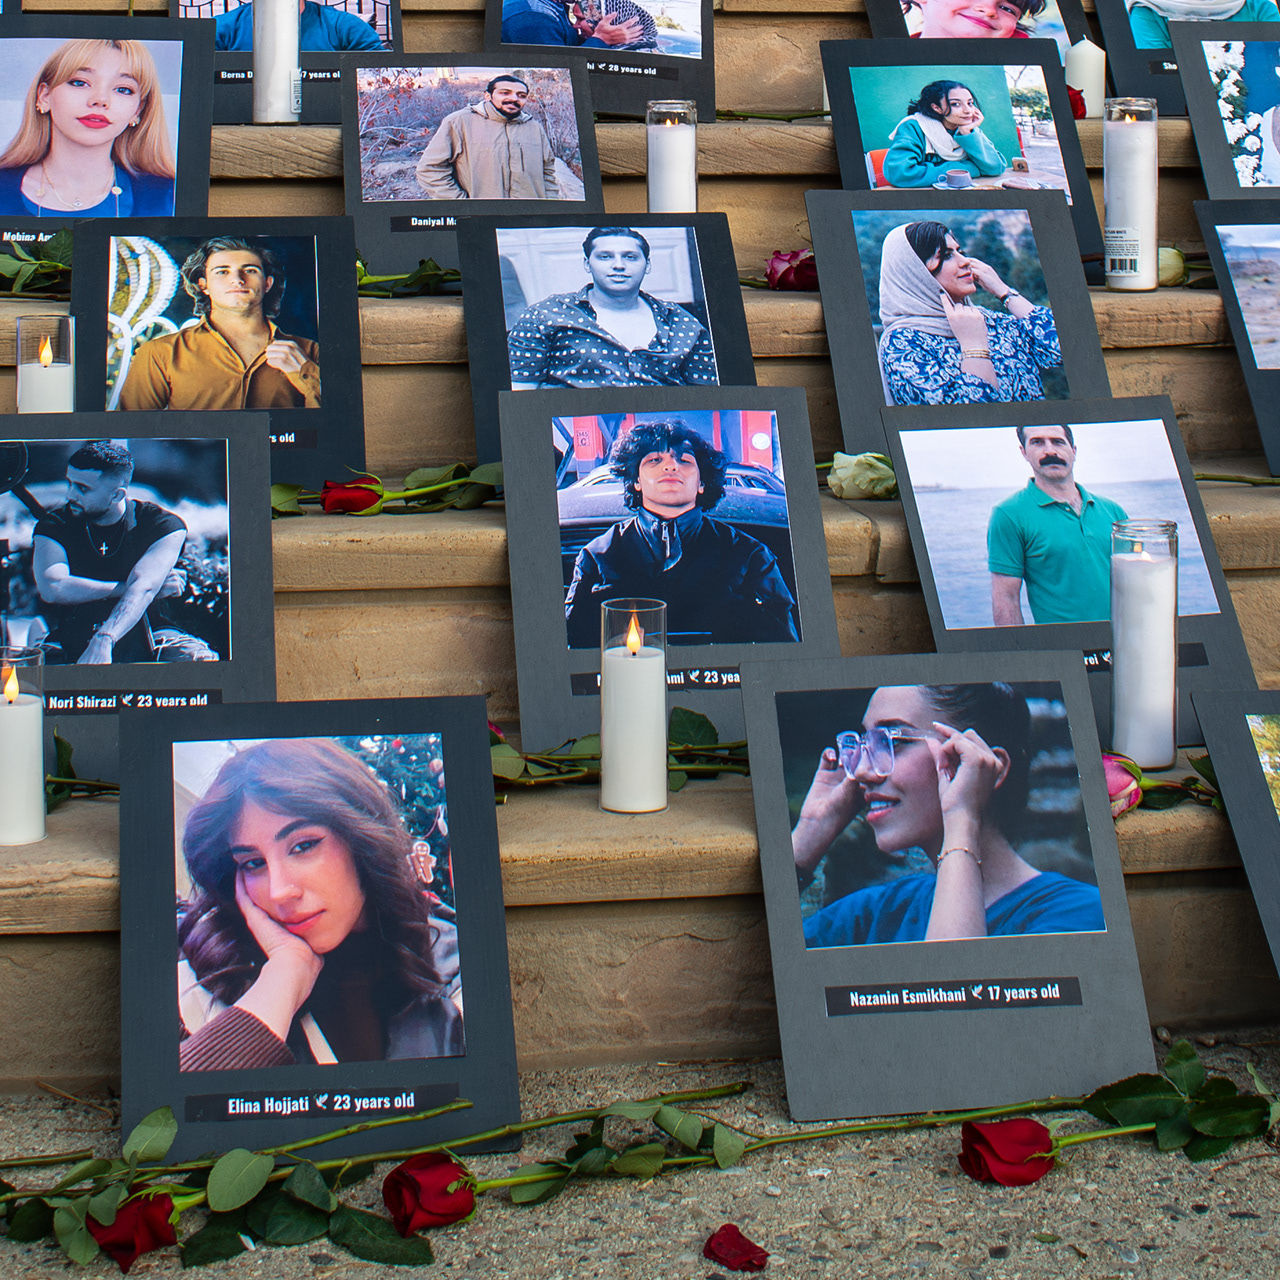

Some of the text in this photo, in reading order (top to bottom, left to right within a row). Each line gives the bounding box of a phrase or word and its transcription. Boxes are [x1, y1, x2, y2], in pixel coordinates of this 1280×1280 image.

[221, 71, 247, 79] Borna
[608, 64, 656, 75] 28 years old
[411, 217, 444, 227] Daniyal
[279, 432, 295, 442] old
[49, 694, 208, 709] Nori Shirazi 23 years old
[850, 983, 1060, 1006] Nazanin Esmikhani 17 years old
[228, 1092, 415, 1115] Elina Hojjati 23 years old
